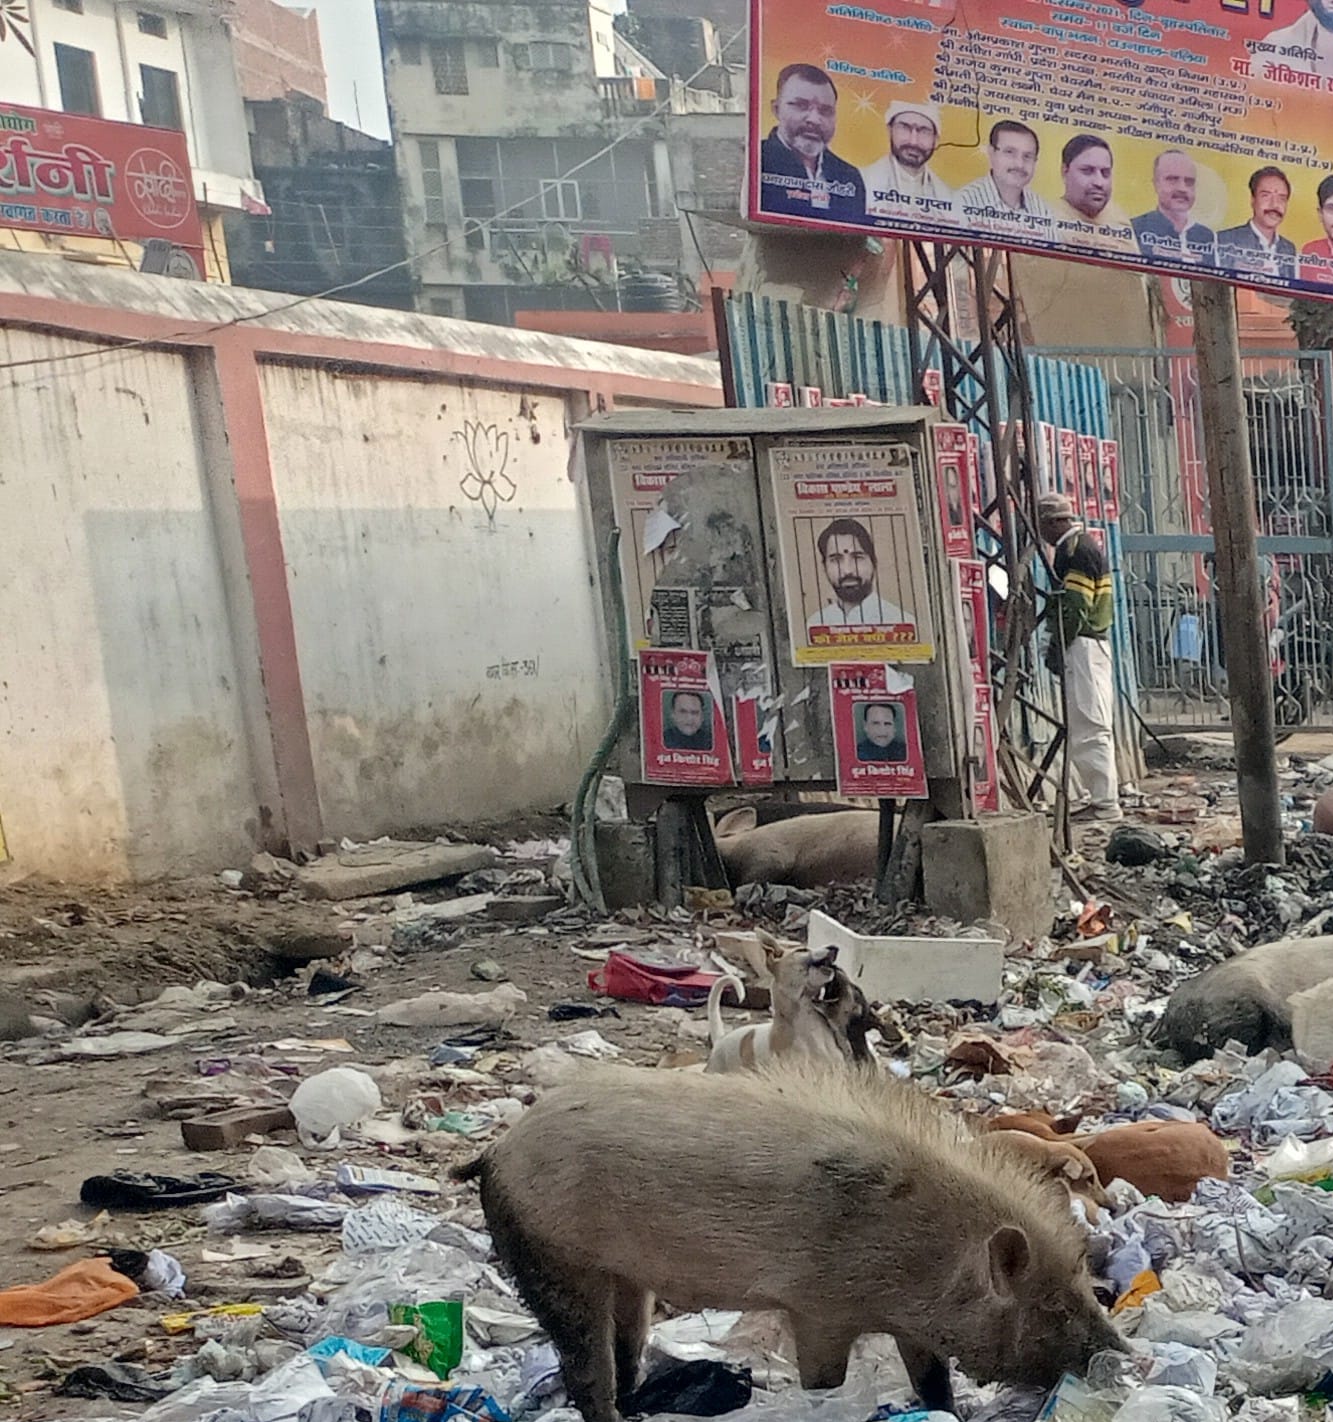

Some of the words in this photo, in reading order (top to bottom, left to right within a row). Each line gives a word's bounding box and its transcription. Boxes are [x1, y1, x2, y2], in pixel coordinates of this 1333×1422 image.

[1052, 12, 1091, 25] समय-
[1112, 22, 1135, 35] बजे
[1137, 25, 1162, 41] दिन
[940, 39, 955, 50] श्री
[1030, 56, 1057, 69] प्रदेश
[1103, 71, 1142, 84] भारतीय
[1246, 40, 1276, 54] मुख्य
[936, 52, 951, 64] श्री
[954, 57, 986, 69] अजय
[989, 63, 1021, 76] कुमार
[1110, 86, 1136, 96] नगर
[1139, 88, 1175, 103] पंचायत
[1064, 50, 1097, 63] सदस्य
[1100, 57, 1139, 70] भारतीय
[1178, 68, 1209, 83] निगम
[1232, 59, 1255, 77] मा.
[1263, 61, 1322, 90] जैकिशन
[975, 71, 1008, 86] विजय
[1076, 90, 1095, 102] मैन
[930, 91, 945, 104] श्री
[1019, 109, 1040, 122] युवा
[1043, 112, 1069, 125] प्रदेश
[1117, 125, 1153, 140] अखिल
[1156, 131, 1194, 146] भारतीय
[933, 79, 948, 91] श्री
[950, 82, 980, 96] प्रदीप
[1044, 100, 1065, 113] युवा
[1068, 104, 1095, 116] प्रदेश
[1141, 118, 1180, 131] भारतीय
[873, 189, 911, 206] प्रदीप
[915, 195, 952, 213] गुप्ता
[40, 207, 72, 226] करता
[962, 205, 1021, 223] राजकिशोर
[1024, 214, 1052, 230] गुप्ता
[1056, 219, 1095, 235] मनोज
[1098, 225, 1133, 240] केशरी
[1236, 272, 1291, 289] बलिया
